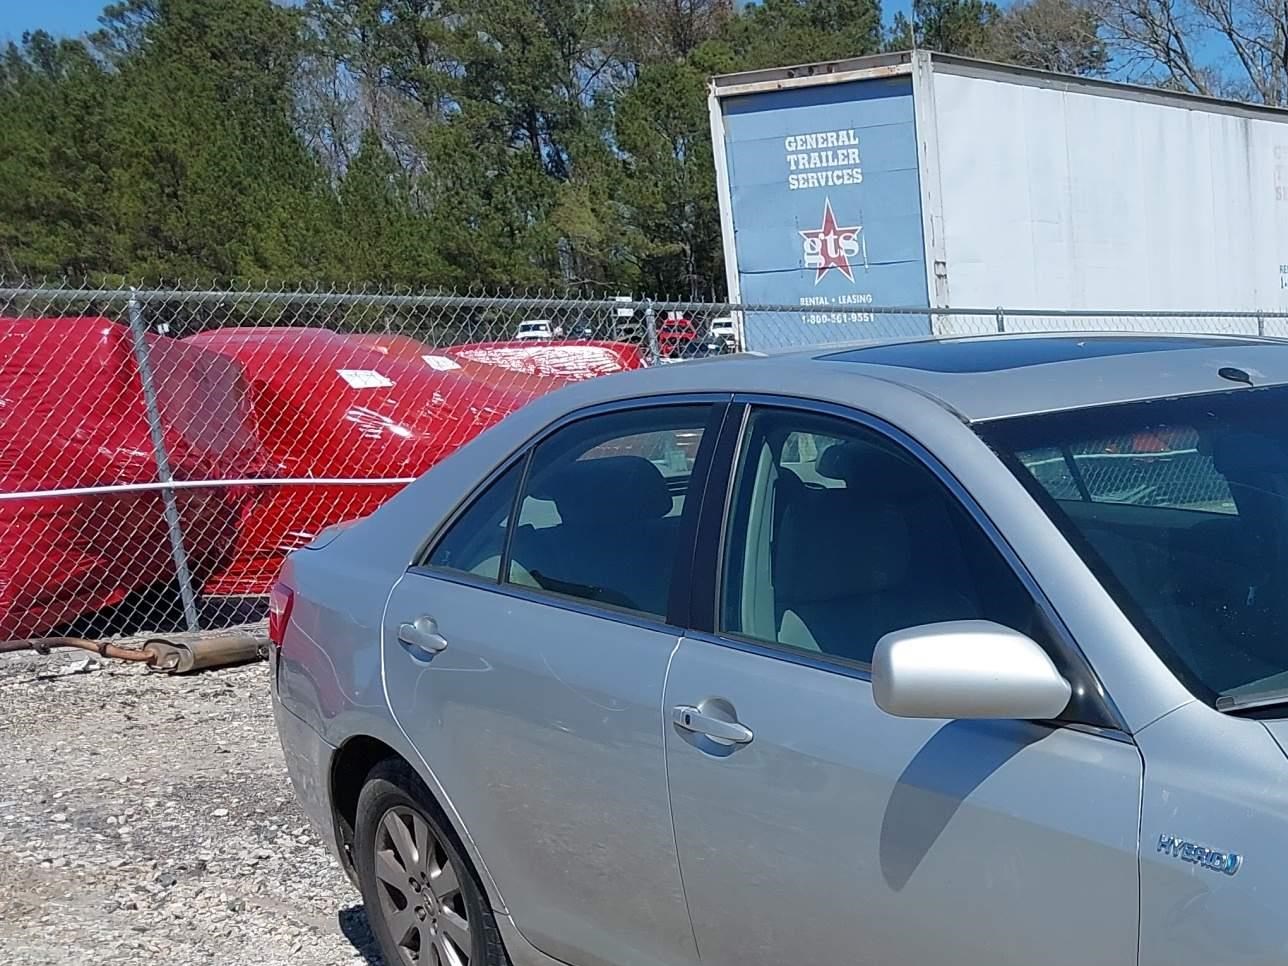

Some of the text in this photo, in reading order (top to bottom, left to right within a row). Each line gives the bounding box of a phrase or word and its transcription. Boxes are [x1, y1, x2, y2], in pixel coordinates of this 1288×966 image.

[785, 129, 859, 151] GENERAL
[787, 149, 861, 170] TRAILER
[789, 168, 863, 190] SERVICES
[803, 231, 860, 268] gts
[800, 294, 873, 306] RENTAL LEASING
[1157, 833, 1241, 876] HYBRID
